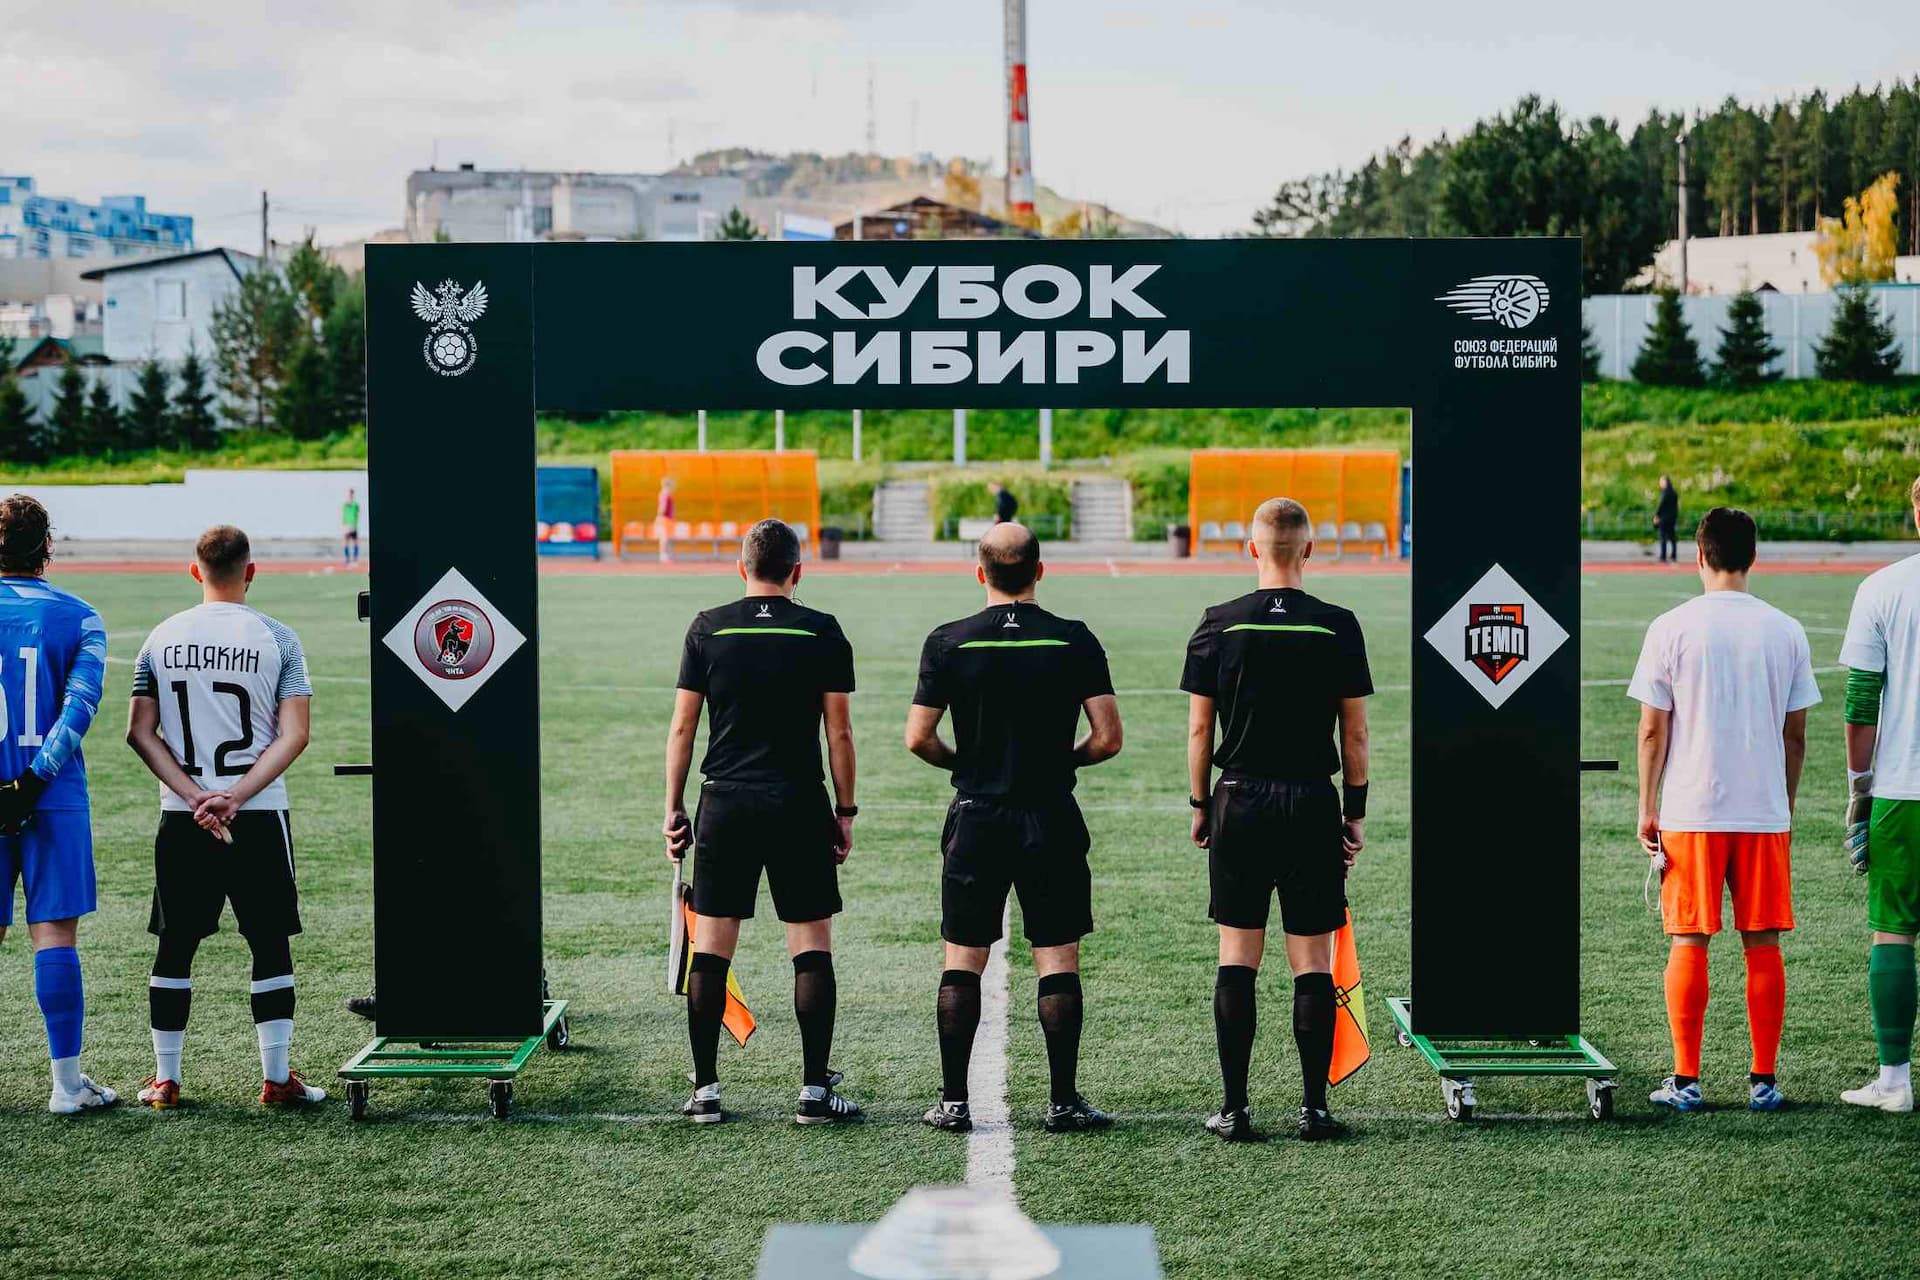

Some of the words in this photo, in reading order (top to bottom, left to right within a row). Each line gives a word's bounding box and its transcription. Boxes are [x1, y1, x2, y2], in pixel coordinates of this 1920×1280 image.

[792, 264, 1167, 319] КУБОК
[756, 330, 1190, 386] СИБИРИ
[1454, 339, 1487, 353] СОЮЗ
[1489, 336, 1558, 355] ФЕДЕРАЦИЙ
[1454, 355, 1509, 369] ФУТБОЛА
[1512, 355, 1558, 369] СИБИРЬ
[1469, 625, 1525, 656] ТЕМП
[163, 644, 260, 674] СЕДЯКИН
[445, 667, 465, 675] ЧИТА
[171, 679, 255, 777] 12
